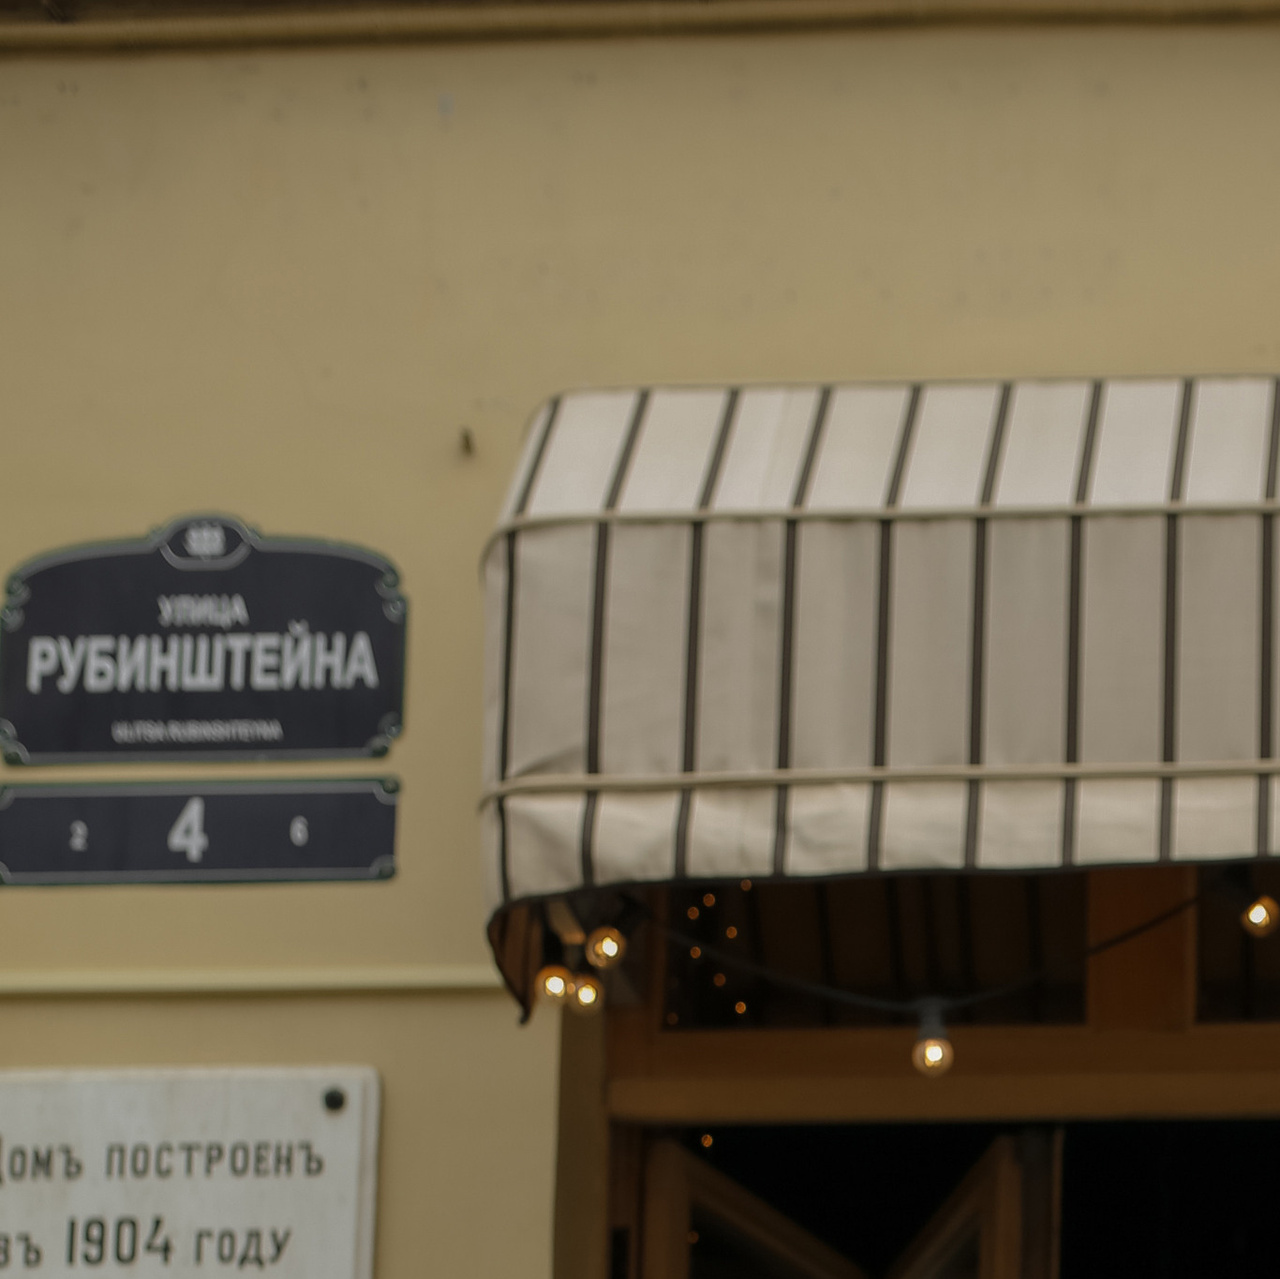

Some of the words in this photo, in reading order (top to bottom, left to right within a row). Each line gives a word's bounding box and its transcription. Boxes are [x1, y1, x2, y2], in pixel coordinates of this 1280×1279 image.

[157, 594, 249, 629] УЛИЦА
[27, 620, 379, 693] РУБИНШТЕЙНА
[69, 819, 89, 852] 2
[167, 796, 209, 863] 4
[289, 815, 309, 847] 6
[0, 1132, 83, 1186] ОМЪ
[106, 1140, 325, 1179] ПОСТРОЕНЪ
[66, 1214, 173, 1267] 1904
[194, 1226, 292, 1269] ГОДУ
